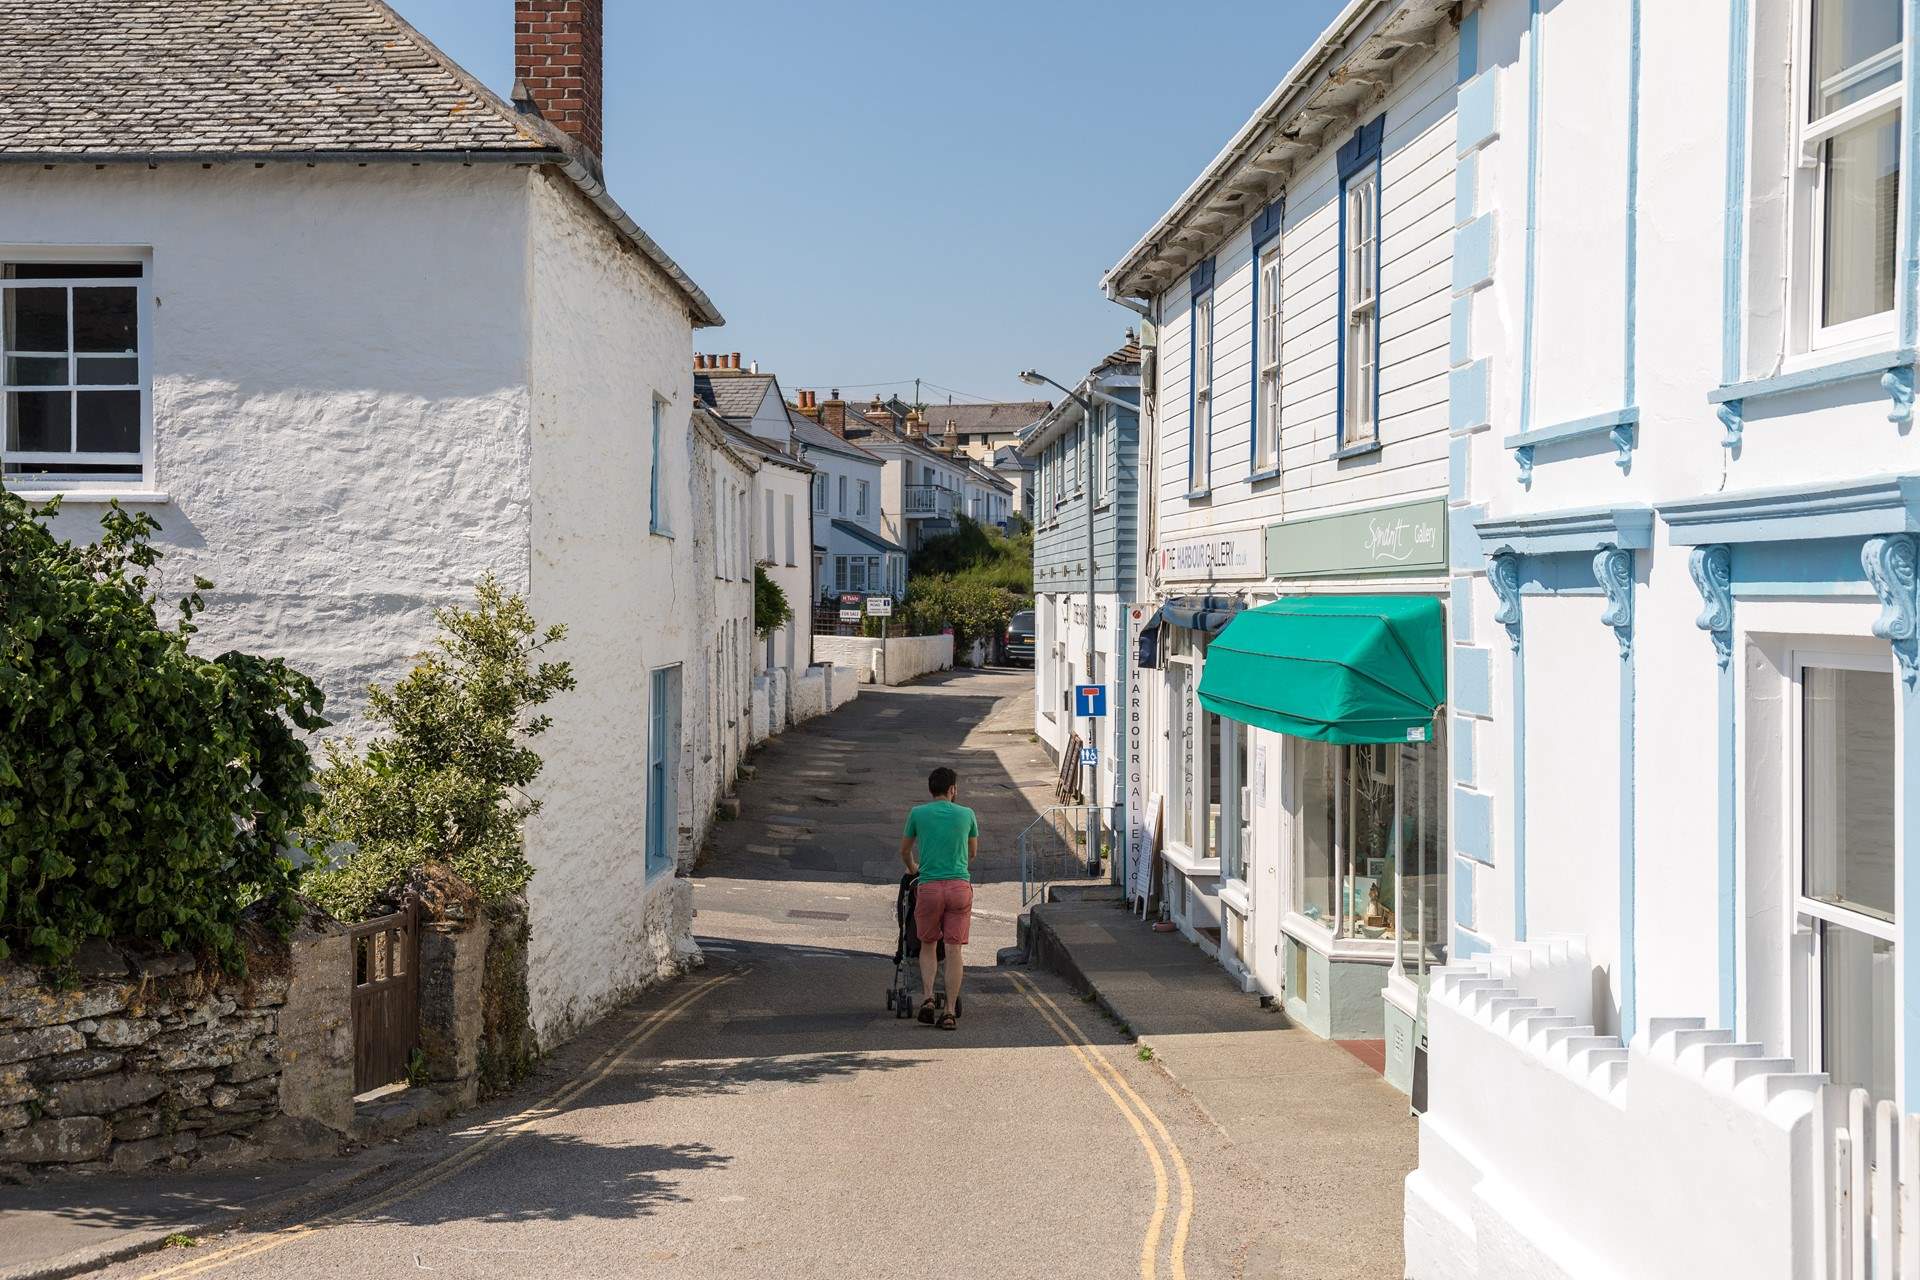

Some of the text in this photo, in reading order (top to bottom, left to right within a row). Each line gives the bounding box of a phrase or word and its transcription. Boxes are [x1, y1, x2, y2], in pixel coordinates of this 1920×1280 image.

[1414, 522, 1436, 548] Gallery
[1166, 547, 1176, 570] THE
[1177, 543, 1205, 569] HARBOUR
[1205, 541, 1234, 568] GALLERY
[1132, 622, 1140, 660] THE
[1131, 670, 1140, 763] HARBOUR
[1131, 773, 1140, 866] GALLERY
